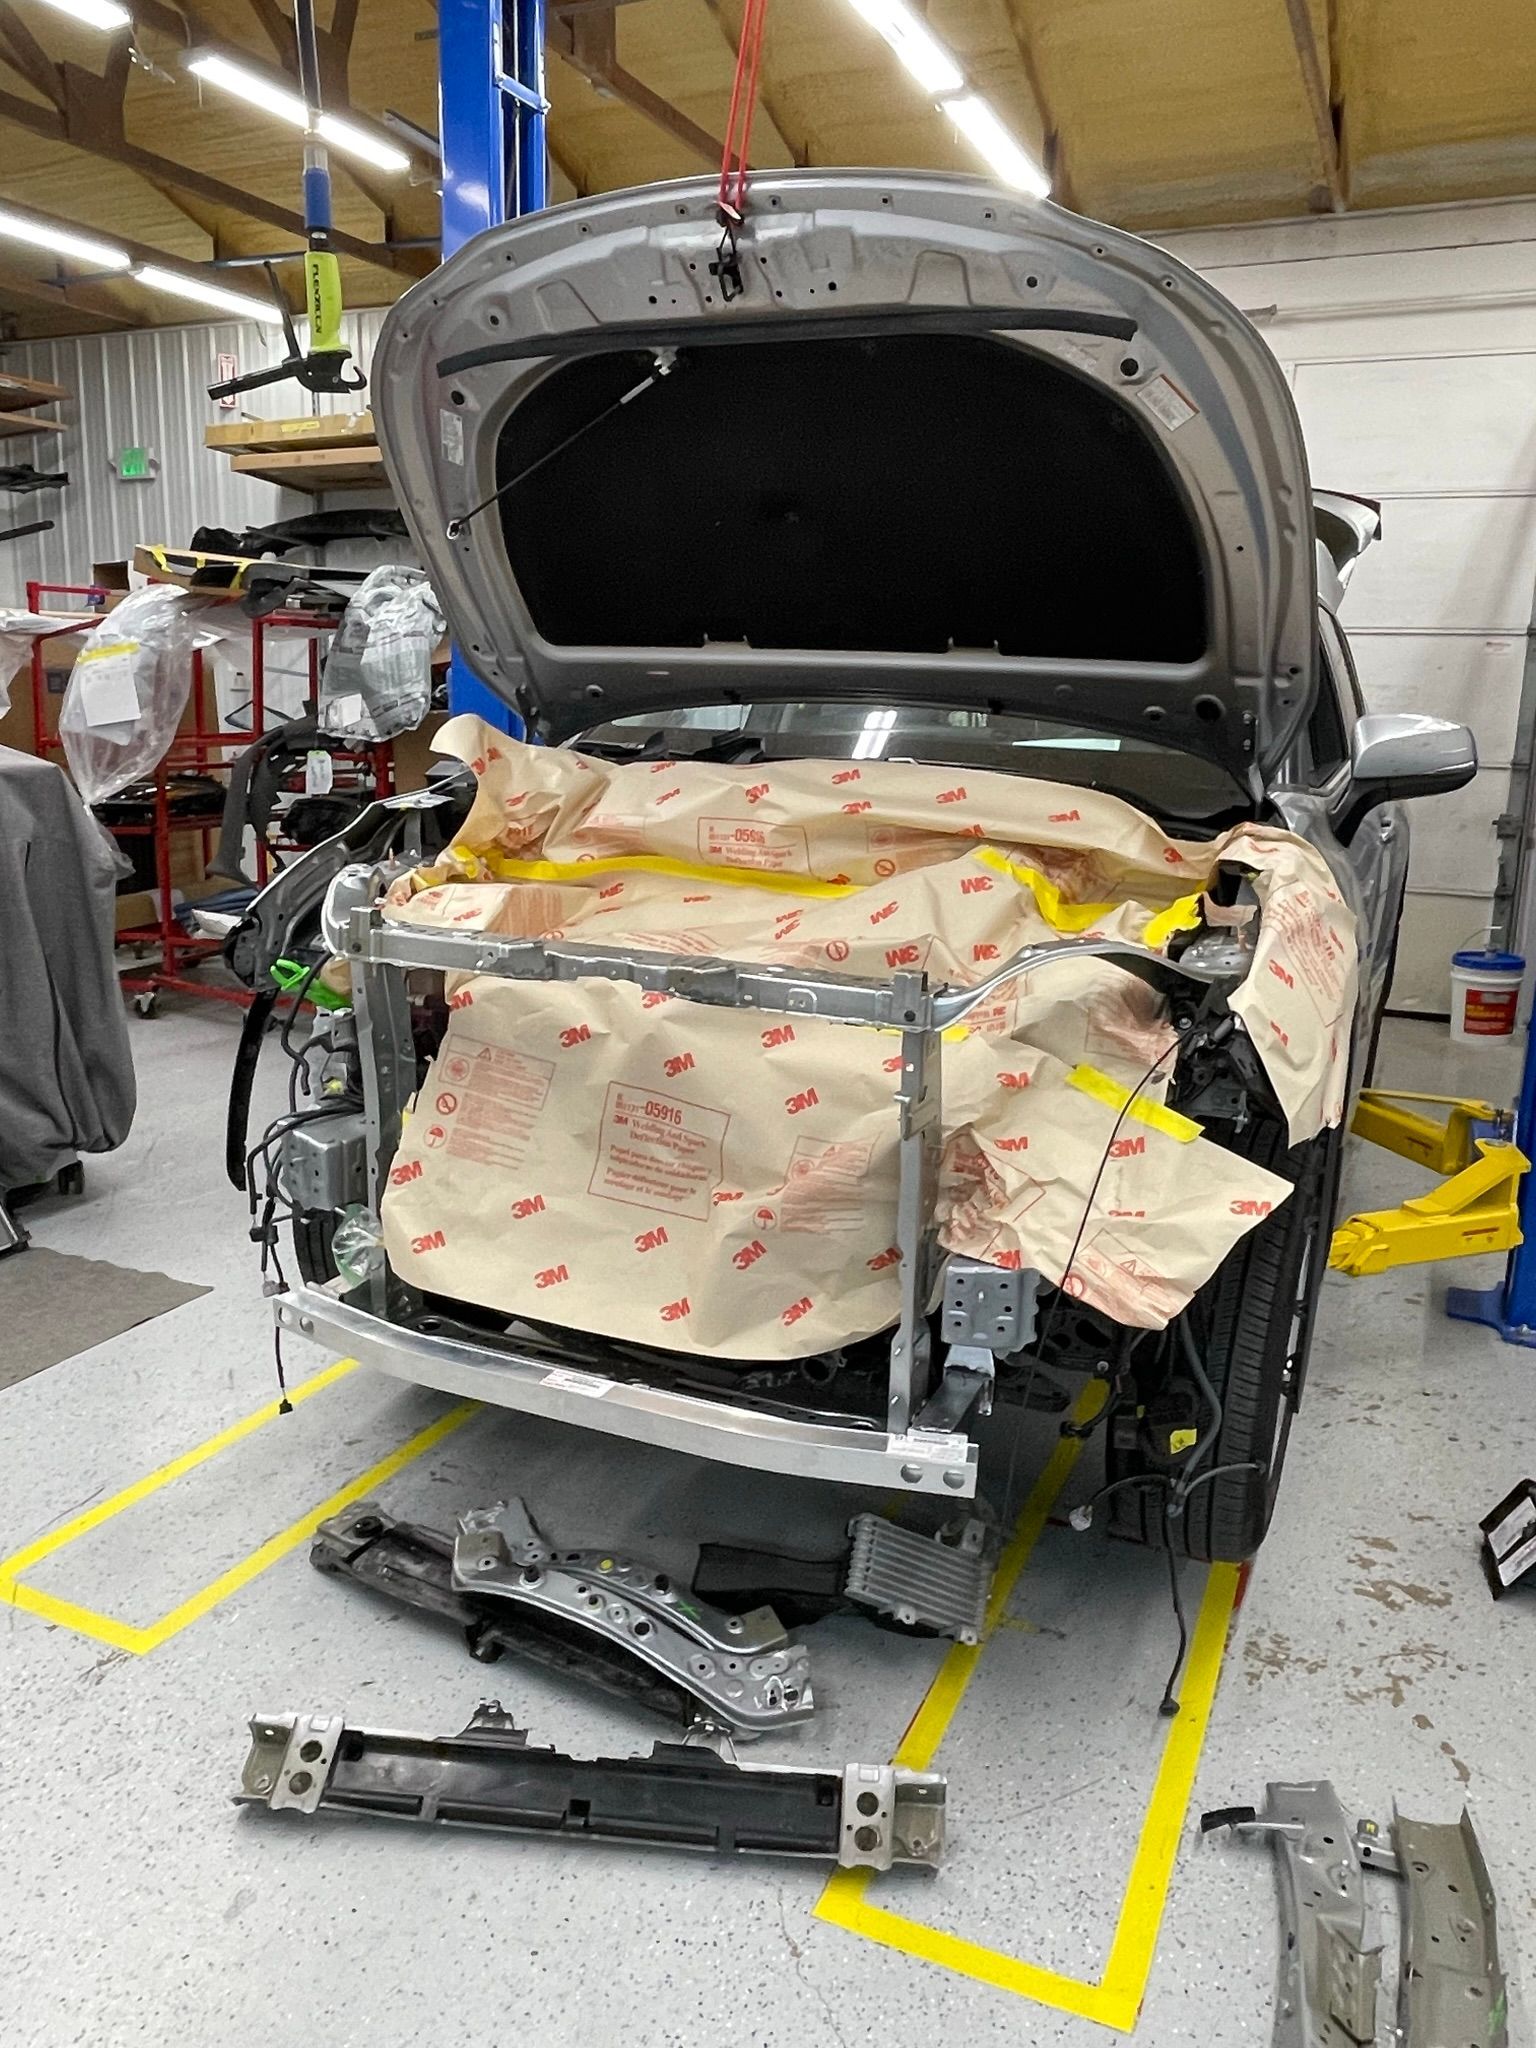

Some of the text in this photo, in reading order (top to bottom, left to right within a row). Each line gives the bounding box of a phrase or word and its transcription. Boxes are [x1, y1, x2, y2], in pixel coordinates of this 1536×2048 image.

[832, 768, 861, 784] 3M
[746, 784, 769, 804] 3M
[937, 788, 966, 804] 3M
[842, 801, 873, 818] 3M
[1049, 810, 1080, 824] 3M
[961, 876, 993, 894] 3M
[870, 902, 899, 925] 3M
[885, 945, 919, 967] 3M
[973, 944, 1000, 961] 3M
[559, 1023, 592, 1048] 3M
[761, 1023, 796, 1048] 3M
[663, 1052, 696, 1077] 3M
[997, 1071, 1030, 1089] 3M
[785, 1087, 820, 1114] 3M
[994, 1136, 1029, 1151] 3M
[1109, 1136, 1146, 1157] 3M
[391, 1160, 424, 1185] 3M
[511, 1194, 546, 1219] 3M
[1230, 1200, 1272, 1215] 3M
[411, 1231, 446, 1254] 3M
[634, 1226, 669, 1253] 3M
[732, 1240, 768, 1269] 3M
[866, 1247, 903, 1271] 3M
[535, 1263, 570, 1288] 3M
[660, 1297, 692, 1322] 3M
[781, 1296, 814, 1325] 3M
